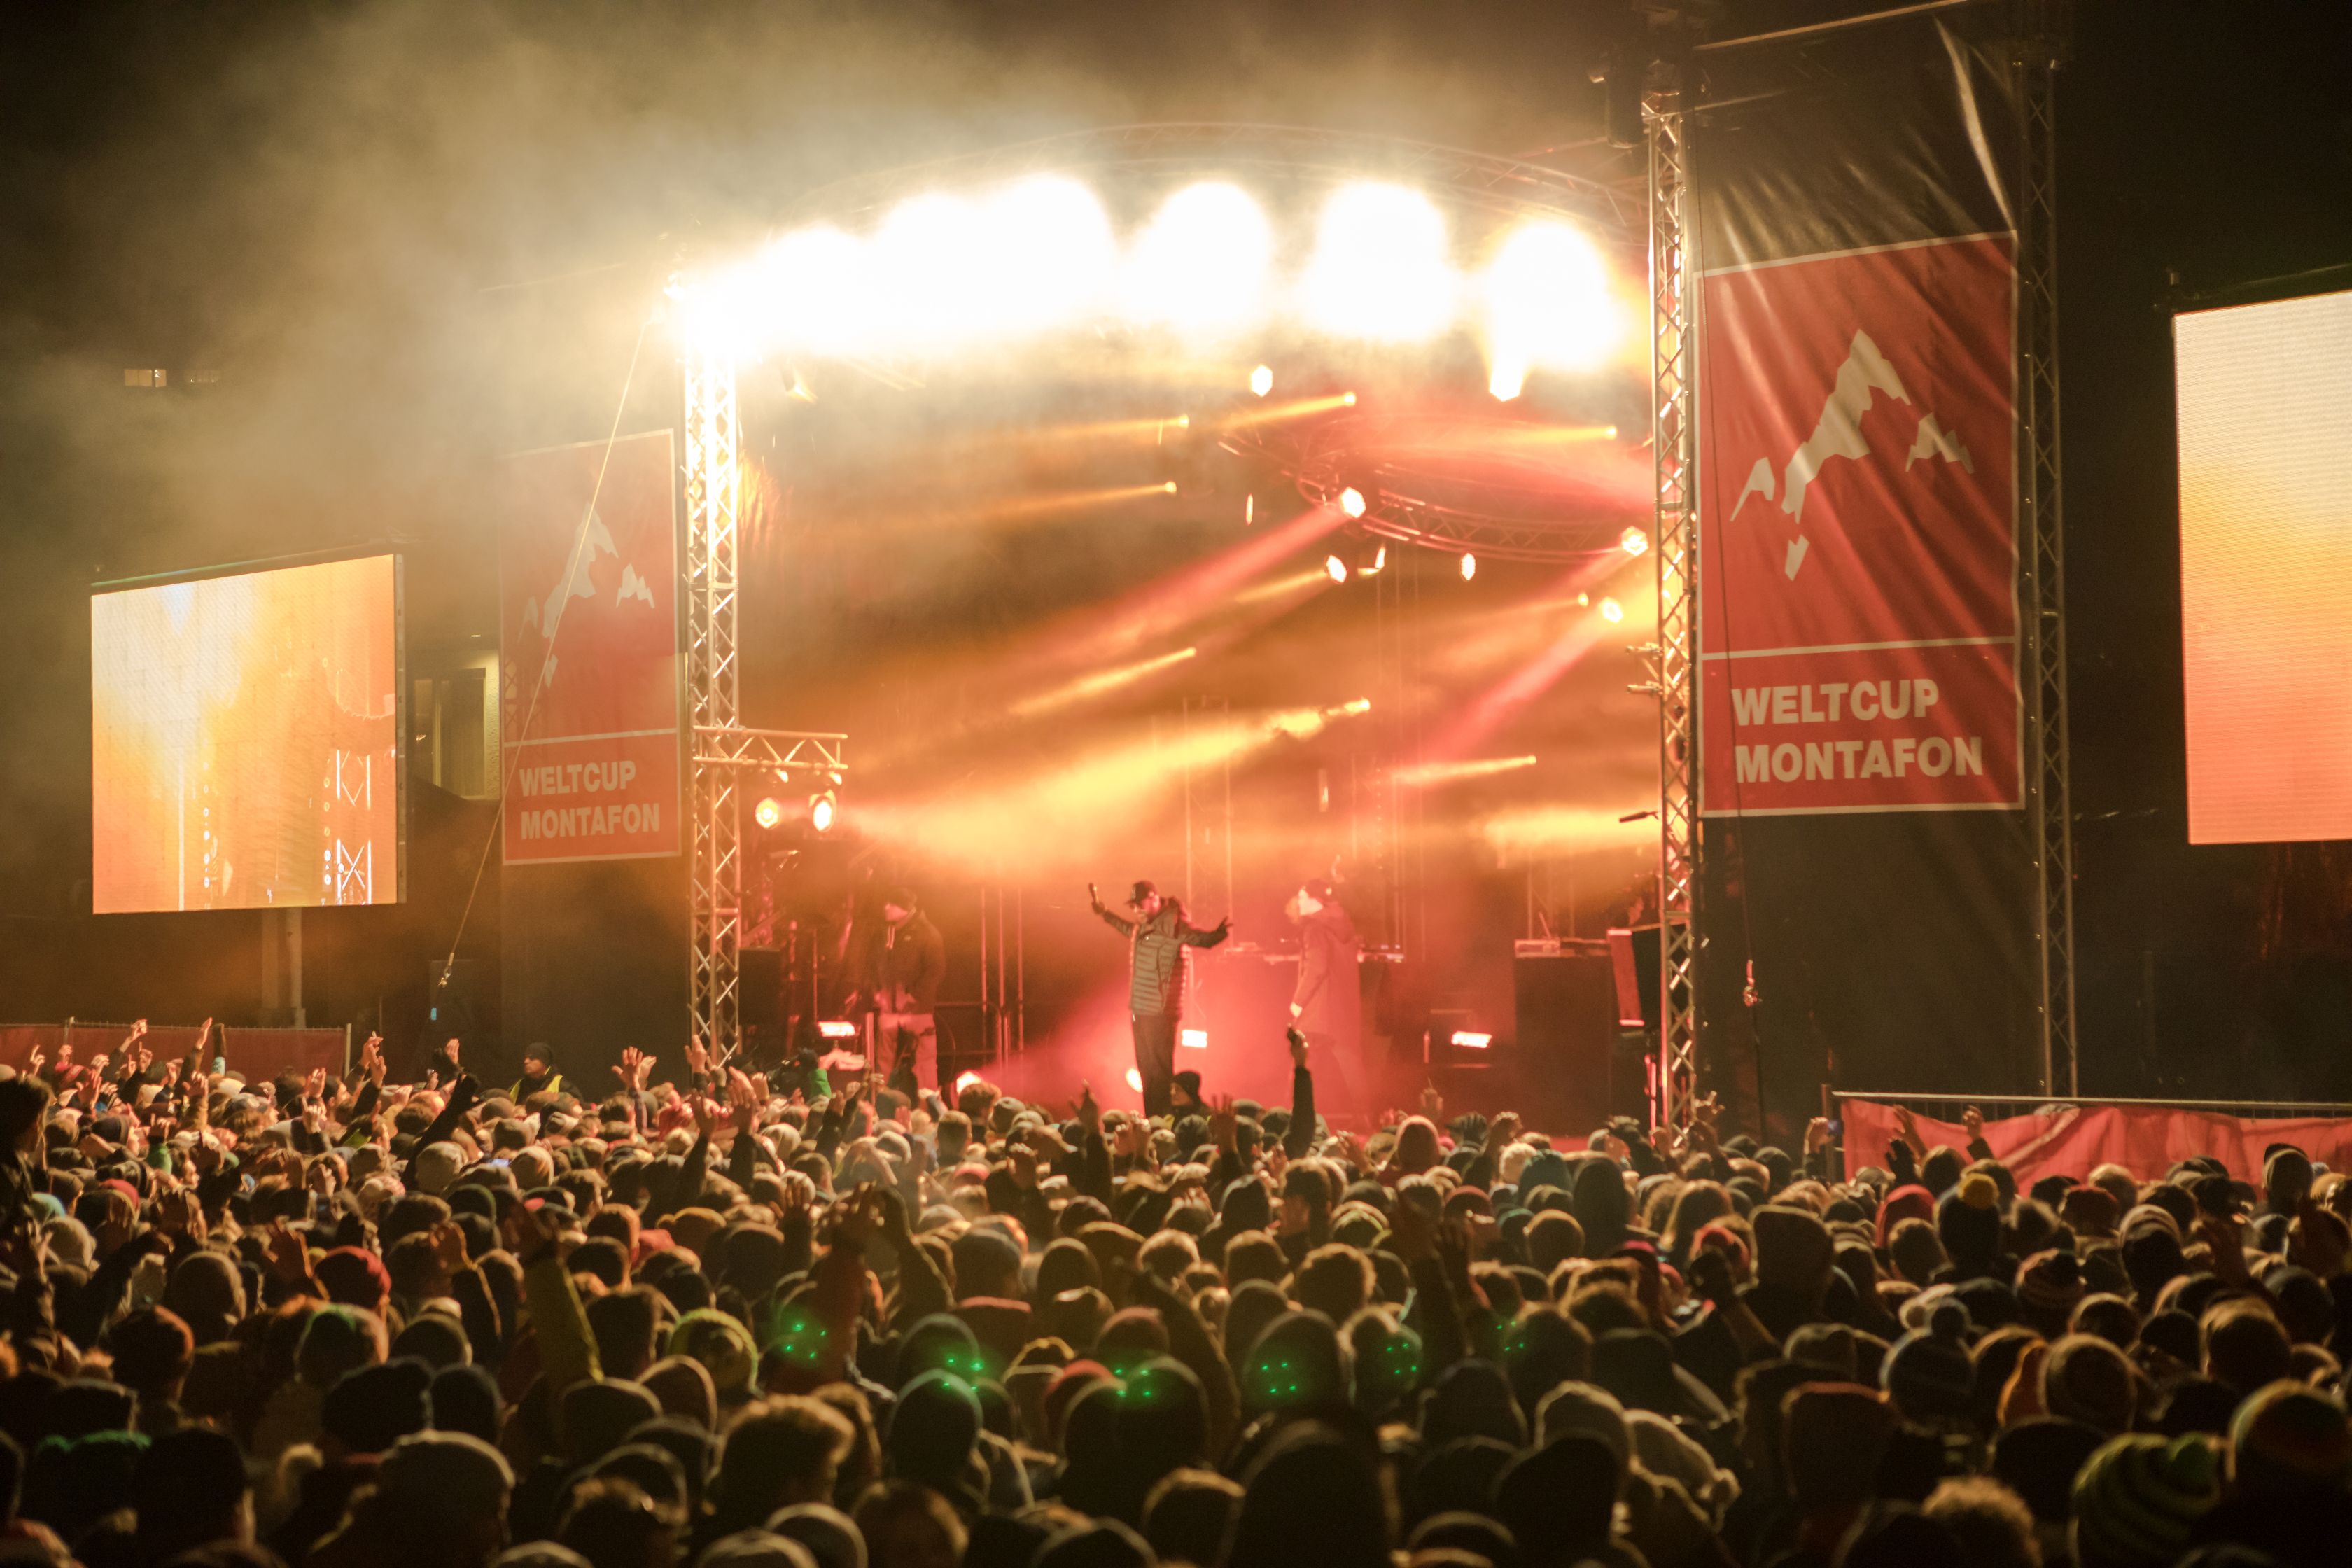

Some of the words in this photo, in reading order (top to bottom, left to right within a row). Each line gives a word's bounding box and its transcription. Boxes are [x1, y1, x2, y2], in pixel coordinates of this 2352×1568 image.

[1732, 679, 1938, 726] WELTCUP
[519, 760, 636, 797] WELTCUP
[1735, 736, 1983, 783] MONTAFON
[521, 803, 659, 839] MONTAFON
